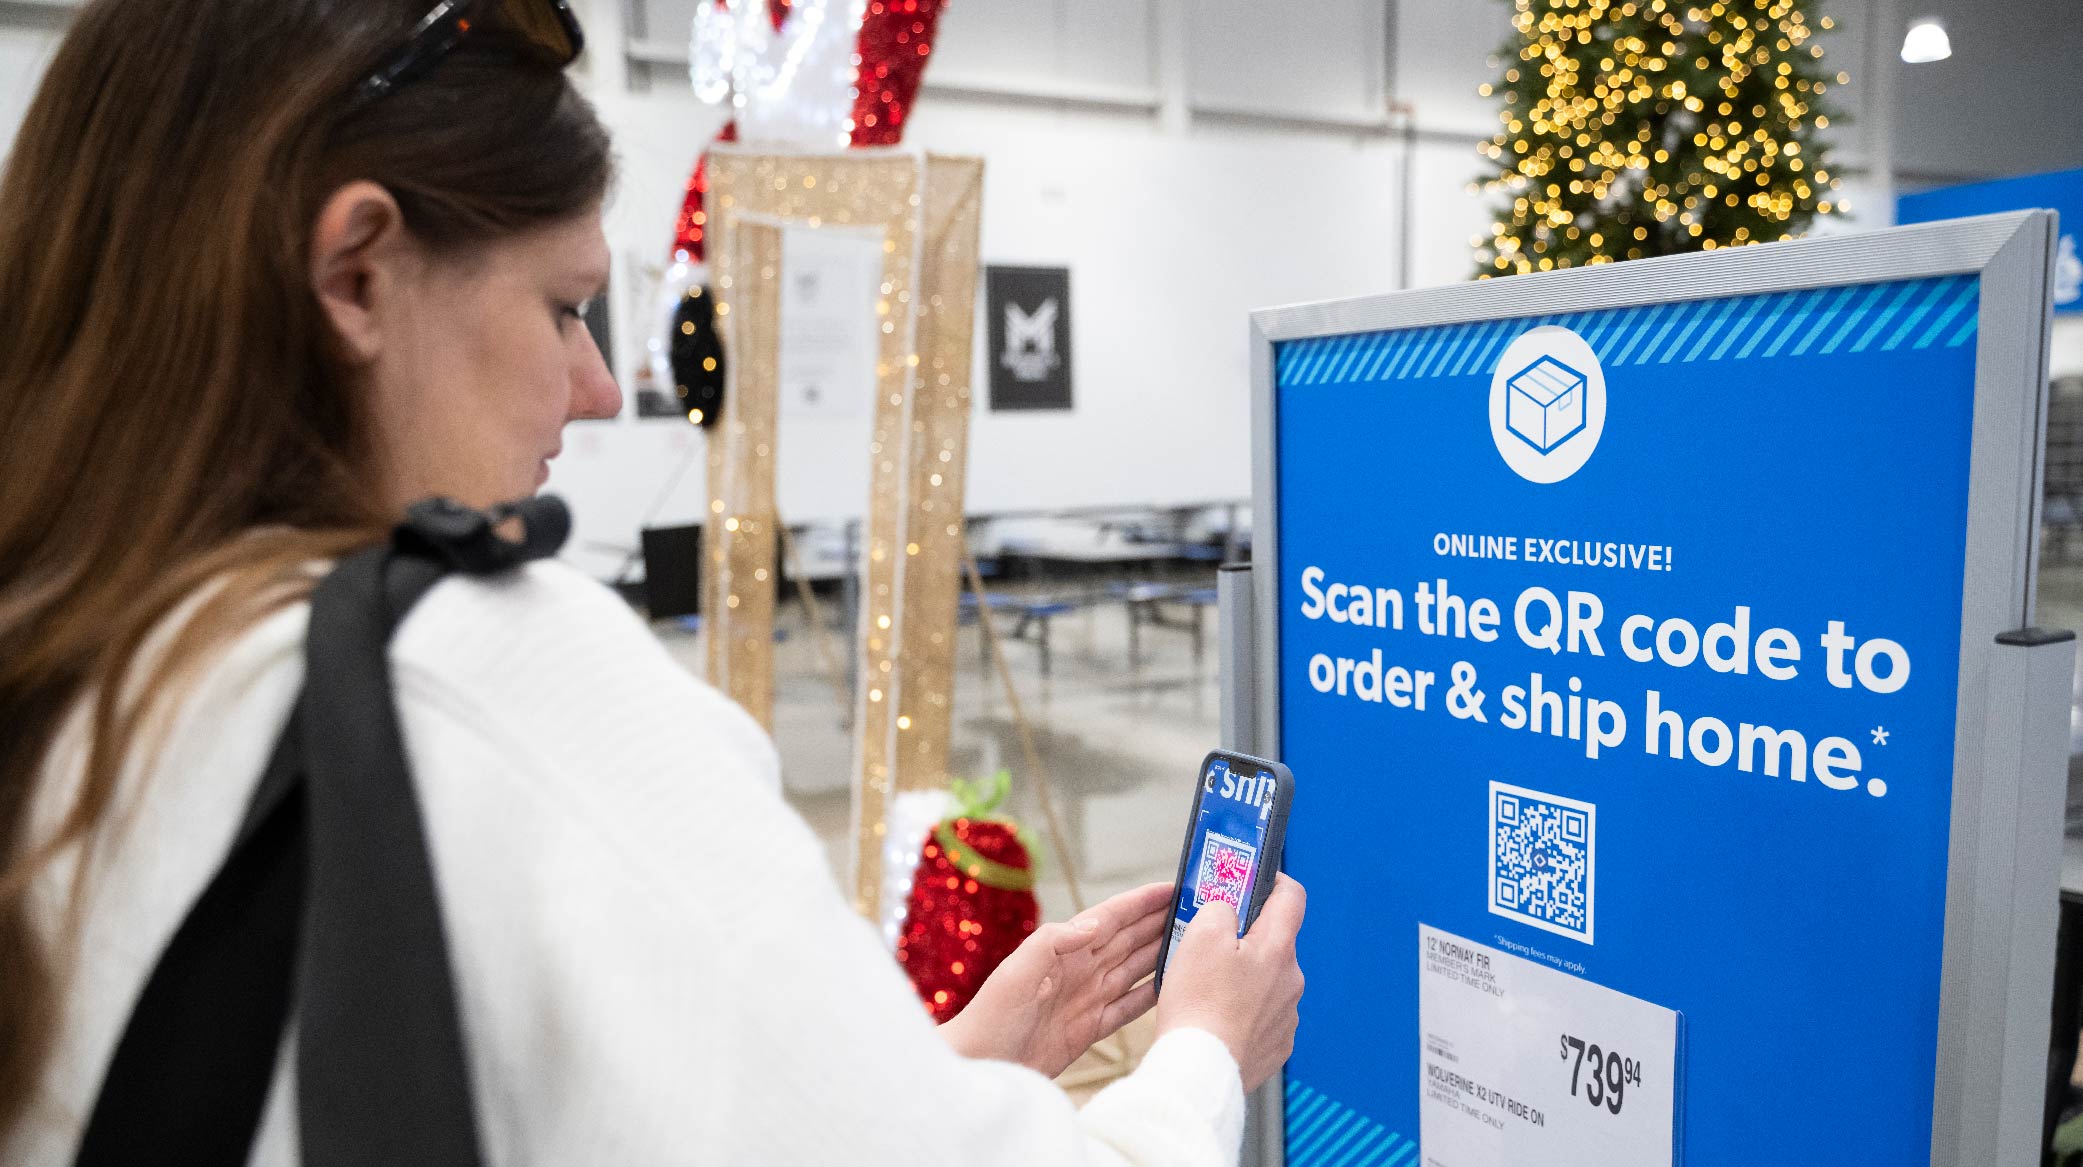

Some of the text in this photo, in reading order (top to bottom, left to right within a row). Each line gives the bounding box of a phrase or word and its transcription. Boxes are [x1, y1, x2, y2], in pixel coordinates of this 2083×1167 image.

[1433, 533, 1673, 571] ONLINE EXCLUSIVE!
[1301, 566, 1911, 694] Scan the QR code to
[1308, 649, 1434, 711] order
[1445, 661, 1489, 723] &
[1500, 673, 1627, 760] ship
[1439, 940, 1474, 964] NORWAY
[1476, 953, 1490, 971] FIR
[1471, 966, 1497, 984] MARK
[1530, 946, 1546, 960] fees
[1546, 953, 1563, 967] may
[1563, 960, 1588, 975] apply.
[1426, 959, 1505, 998] LIMITED TIME ONLY
[1426, 1063, 1545, 1128] WOLVERINE X2 UTV RIDE ON
[1426, 1087, 1505, 1131] LIMITED TIME ONLY
